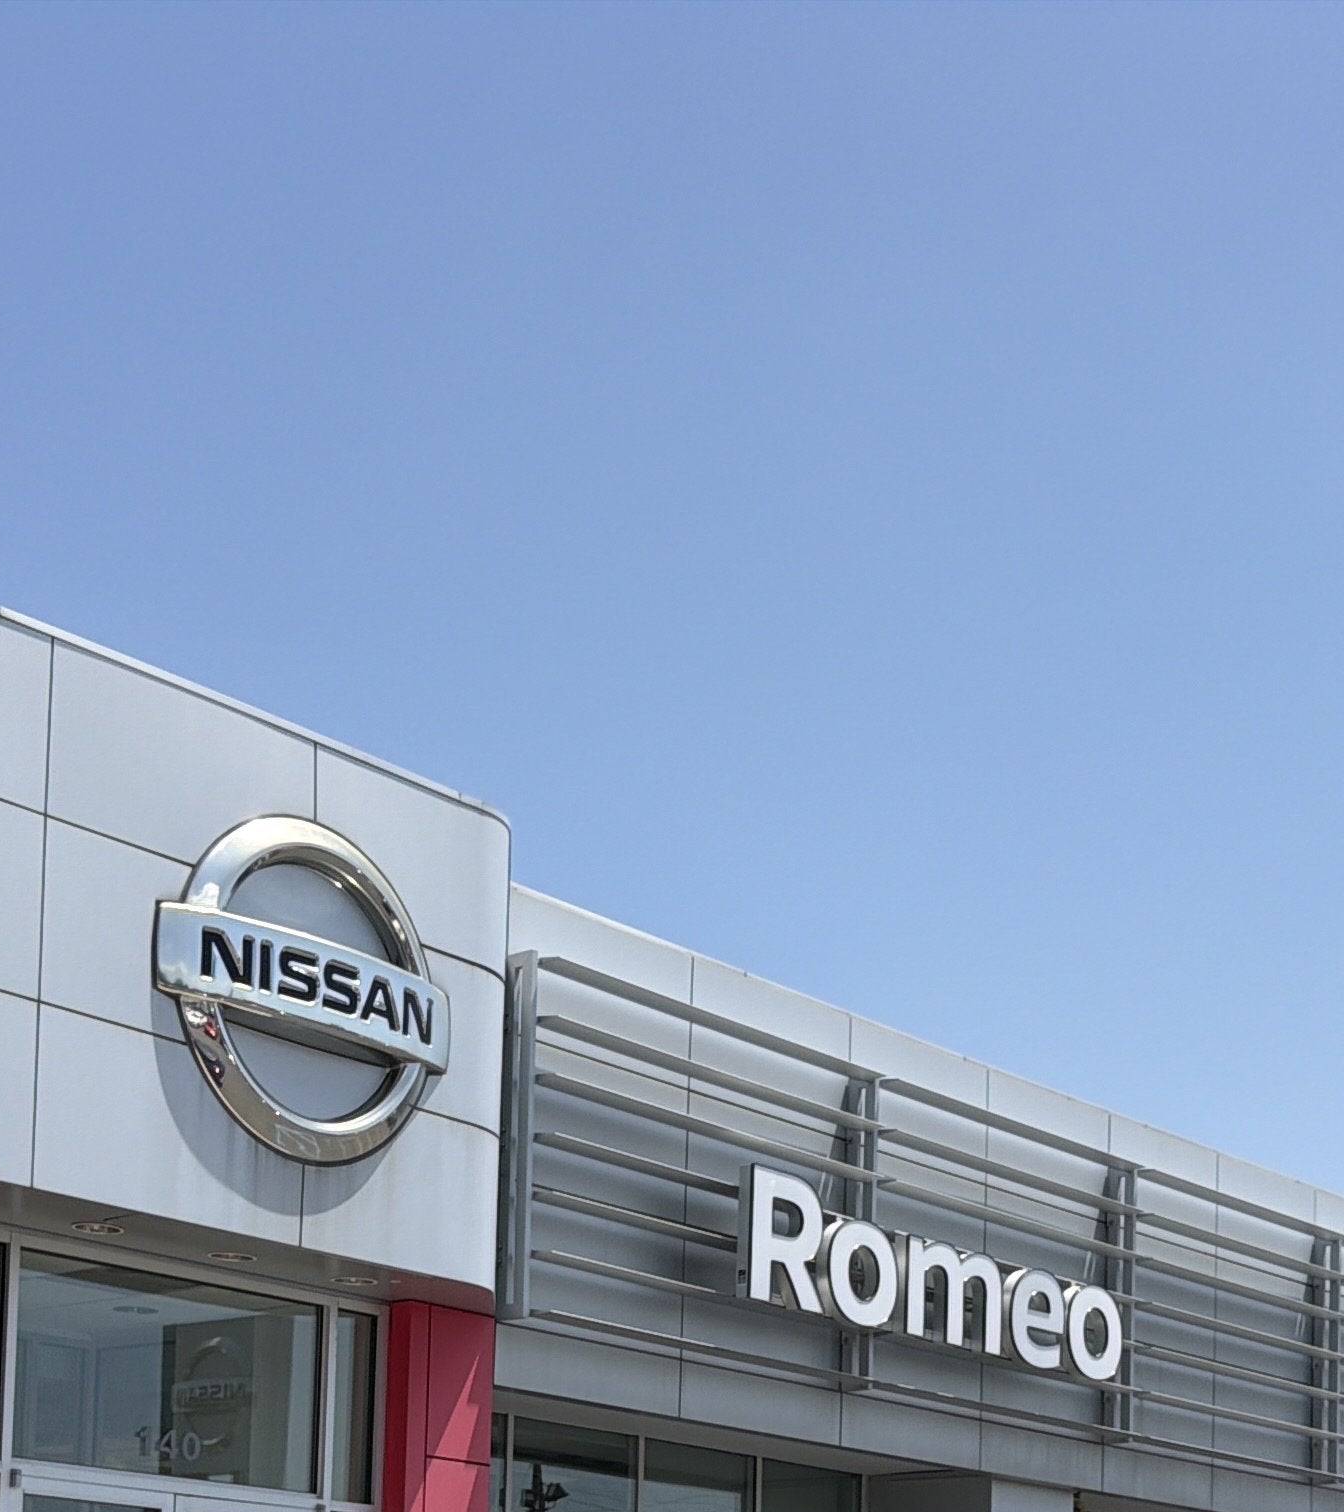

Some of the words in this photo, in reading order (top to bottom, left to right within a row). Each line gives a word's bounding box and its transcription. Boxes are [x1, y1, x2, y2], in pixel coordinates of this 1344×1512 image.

[200, 924, 434, 1048] NISSAN
[744, 1162, 1123, 1381] Romeo
[135, 1426, 201, 1460] 140
